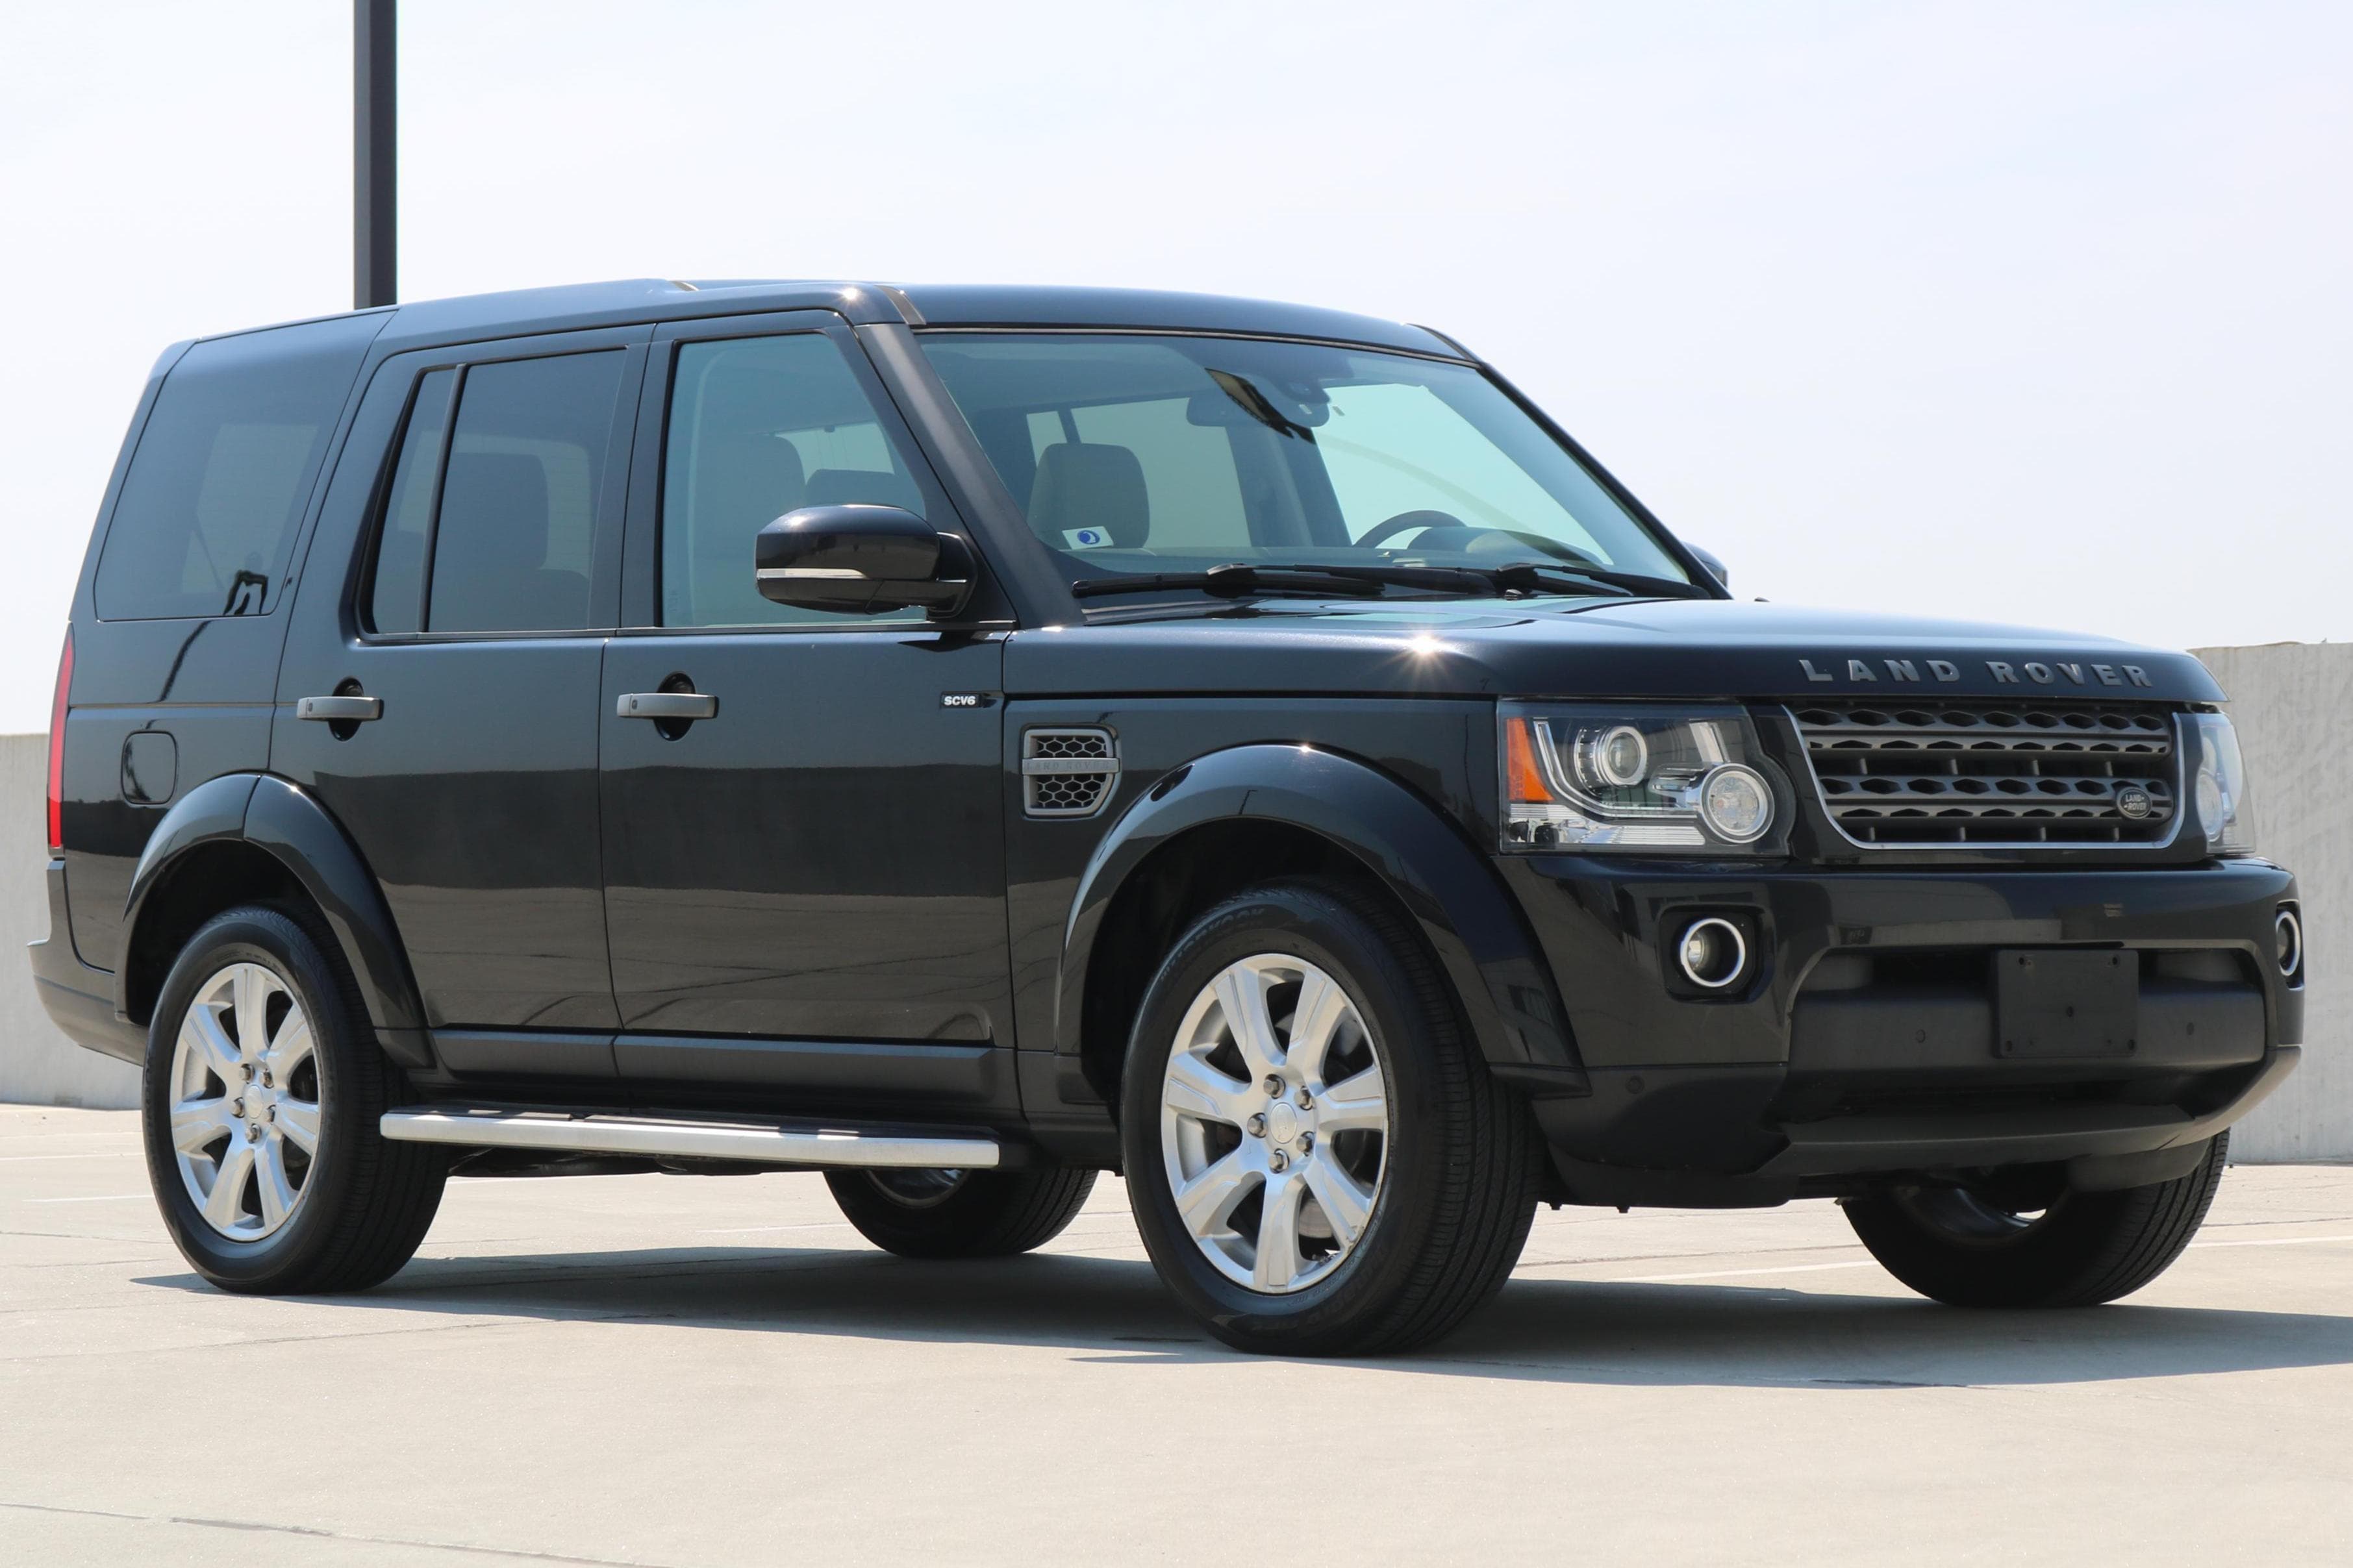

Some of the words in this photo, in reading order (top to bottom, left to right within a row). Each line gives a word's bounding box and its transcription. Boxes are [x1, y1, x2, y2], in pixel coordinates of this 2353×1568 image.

[1798, 659, 1961, 682] LAND
[1985, 660, 2153, 688] ROVER
[944, 695, 976, 706] SCV6
[1026, 761, 1059, 771] LAND
[2125, 794, 2142, 803] LAND
[2127, 802, 2146, 811] ROVER
